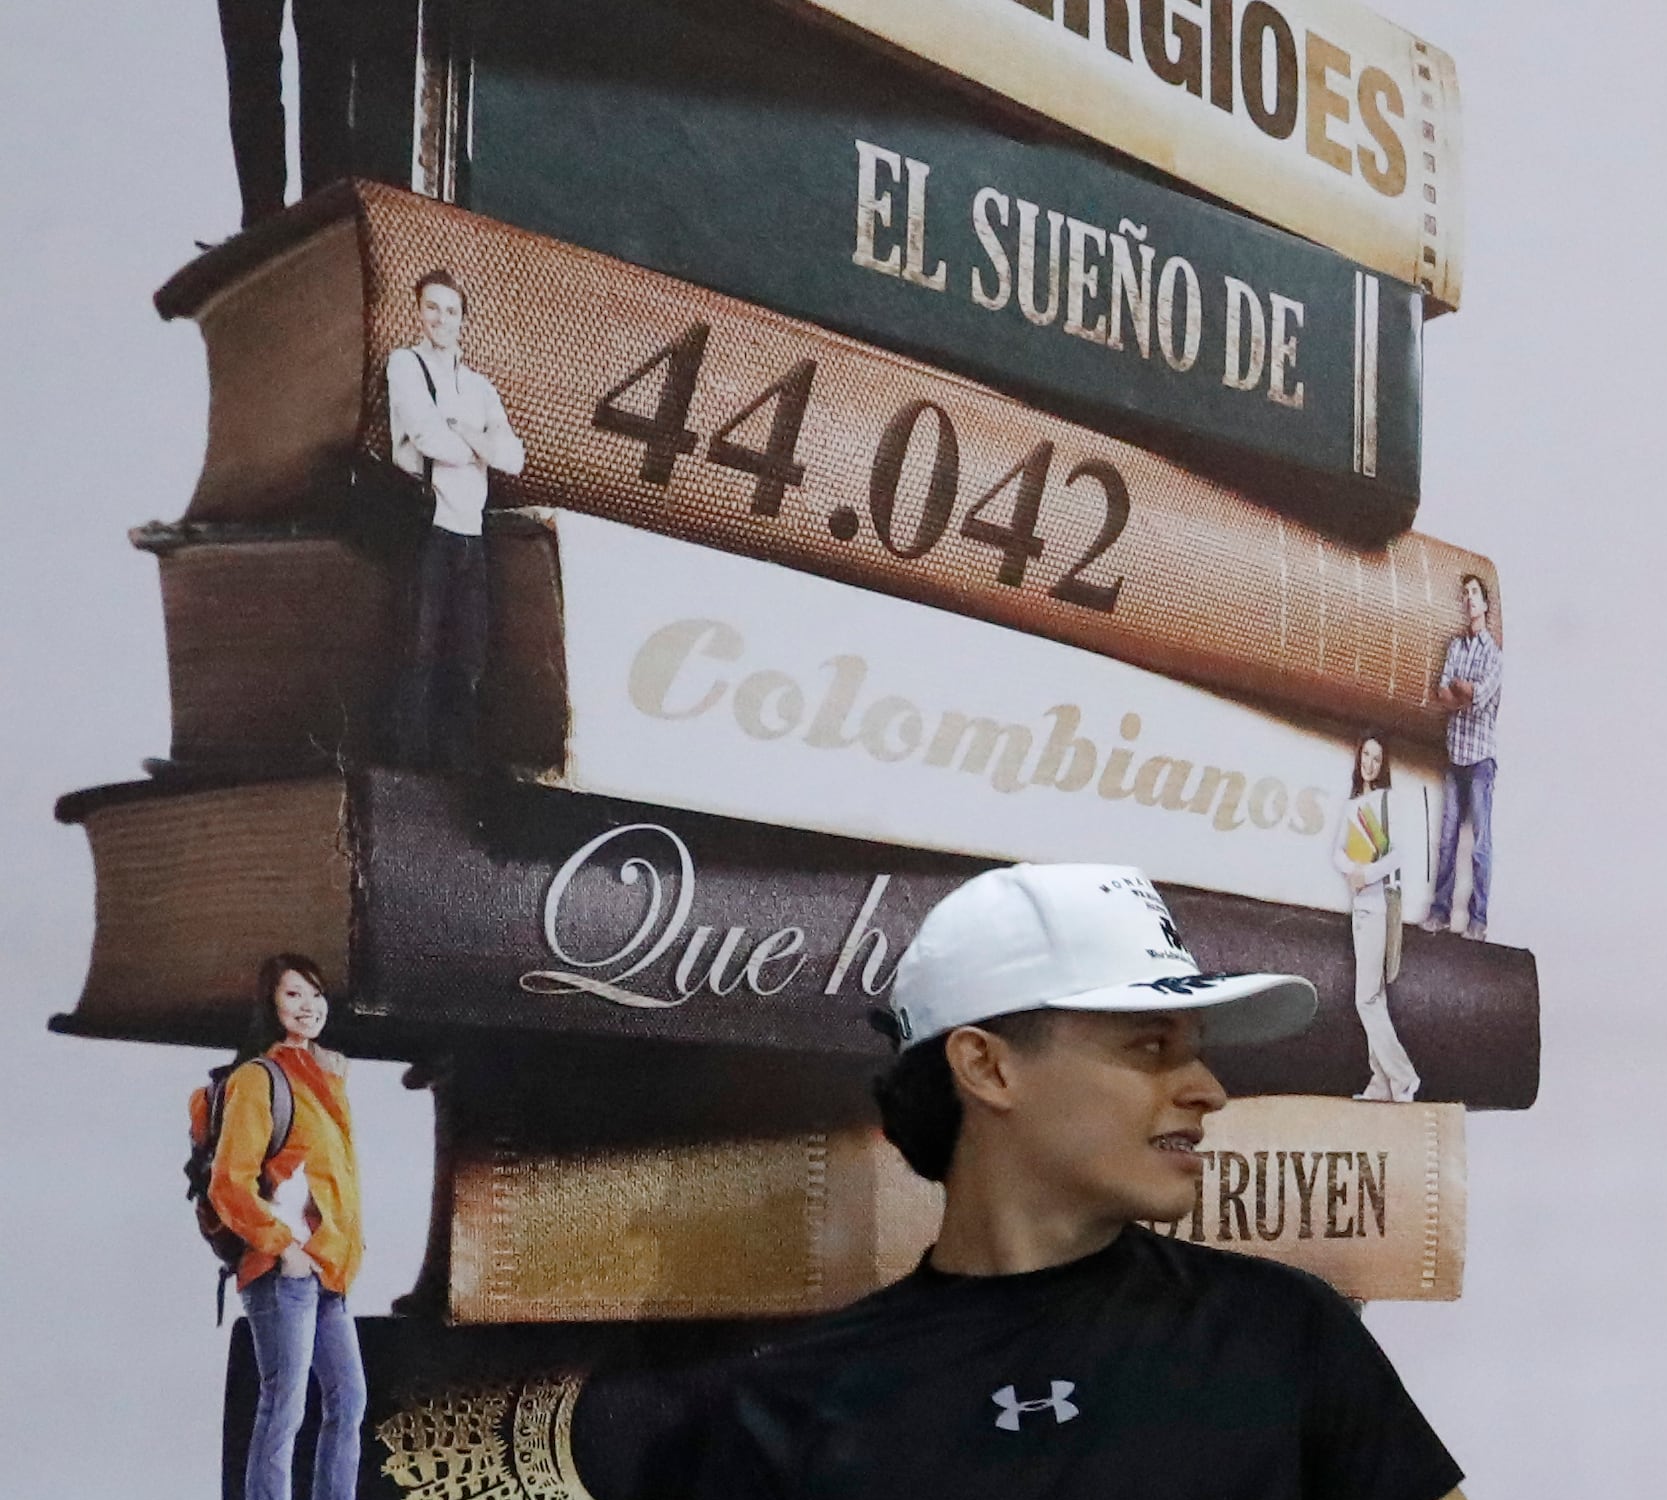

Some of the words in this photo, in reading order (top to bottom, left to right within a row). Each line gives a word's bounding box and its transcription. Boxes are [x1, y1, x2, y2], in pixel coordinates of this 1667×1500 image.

[852, 138, 948, 292] EL
[971, 184, 1202, 373] SUEÑO
[1224, 275, 1305, 409] DE
[593, 323, 1131, 613] 44.042
[628, 618, 1327, 838] Colombianos
[519, 823, 809, 1009] Que
[1151, 1150, 1389, 1242] TRUYEN
